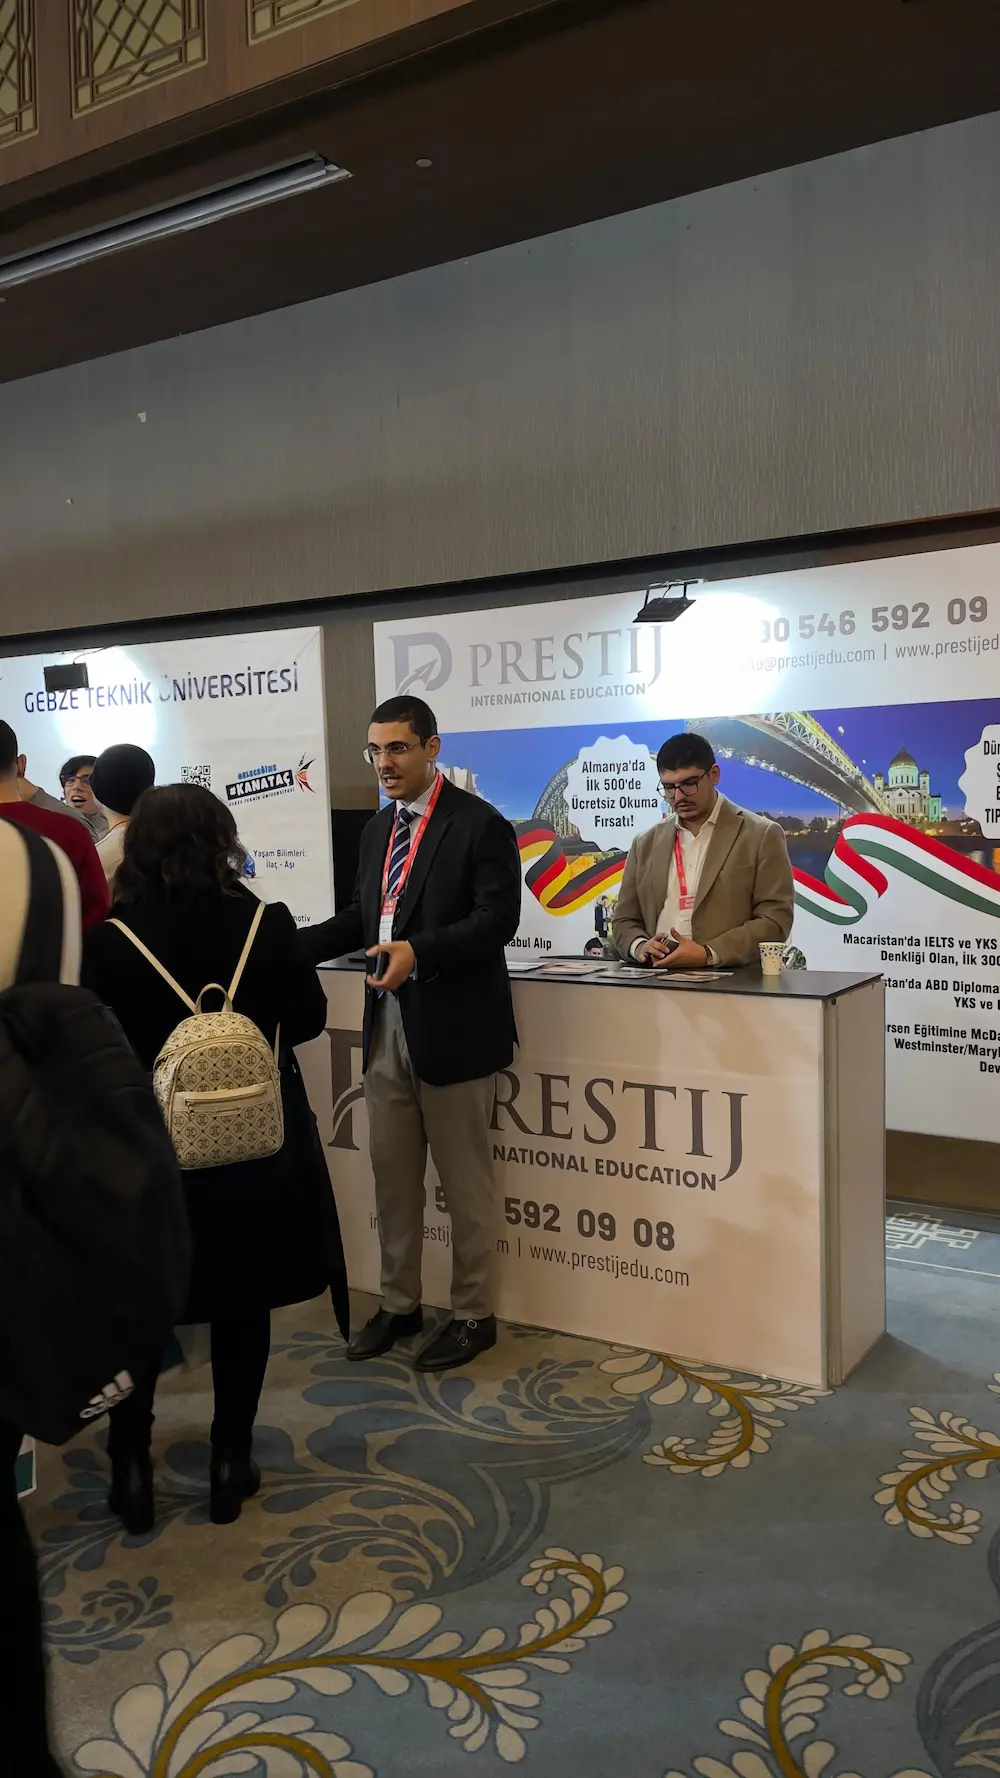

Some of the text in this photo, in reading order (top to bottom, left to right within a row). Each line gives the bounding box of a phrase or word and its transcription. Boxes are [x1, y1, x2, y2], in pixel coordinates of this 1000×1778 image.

[799, 610, 856, 640] 546
[871, 602, 930, 632] 592
[947, 596, 988, 625] 09
[468, 625, 664, 688] PRESTIJ
[25, 661, 299, 713] GEBZE TEKNİK ÜNİVERSİTESİ
[471, 682, 646, 708] INTERNATIONAL EDUCATION
[581, 759, 646, 775] Almanya'da
[229, 771, 291, 796] #KANATAÇ
[586, 776, 641, 792] İlk 500'de
[571, 794, 658, 810] Ücretsiz Okuma
[594, 814, 634, 828] Fırsatı!
[253, 848, 307, 859] Yaşam Bilimleri:
[284, 860, 295, 870] Aşı
[533, 937, 552, 951] Alıp
[843, 933, 998, 950] Macaristan'da IELTS ve YKS
[880, 950, 925, 965] Denkliği
[929, 952, 959, 967] Olan,
[962, 951, 977, 965] İlk
[925, 979, 949, 991] ABD
[952, 980, 1000, 995] Diploma
[954, 996, 976, 1009] YKS
[980, 1000, 993, 1010] ve
[914, 1023, 967, 1039] Eğitimine
[595, 1158, 717, 1191] EDUCATION
[504, 1196, 675, 1251] 592 09 08
[529, 1243, 690, 1287] www.prestijedu.com
